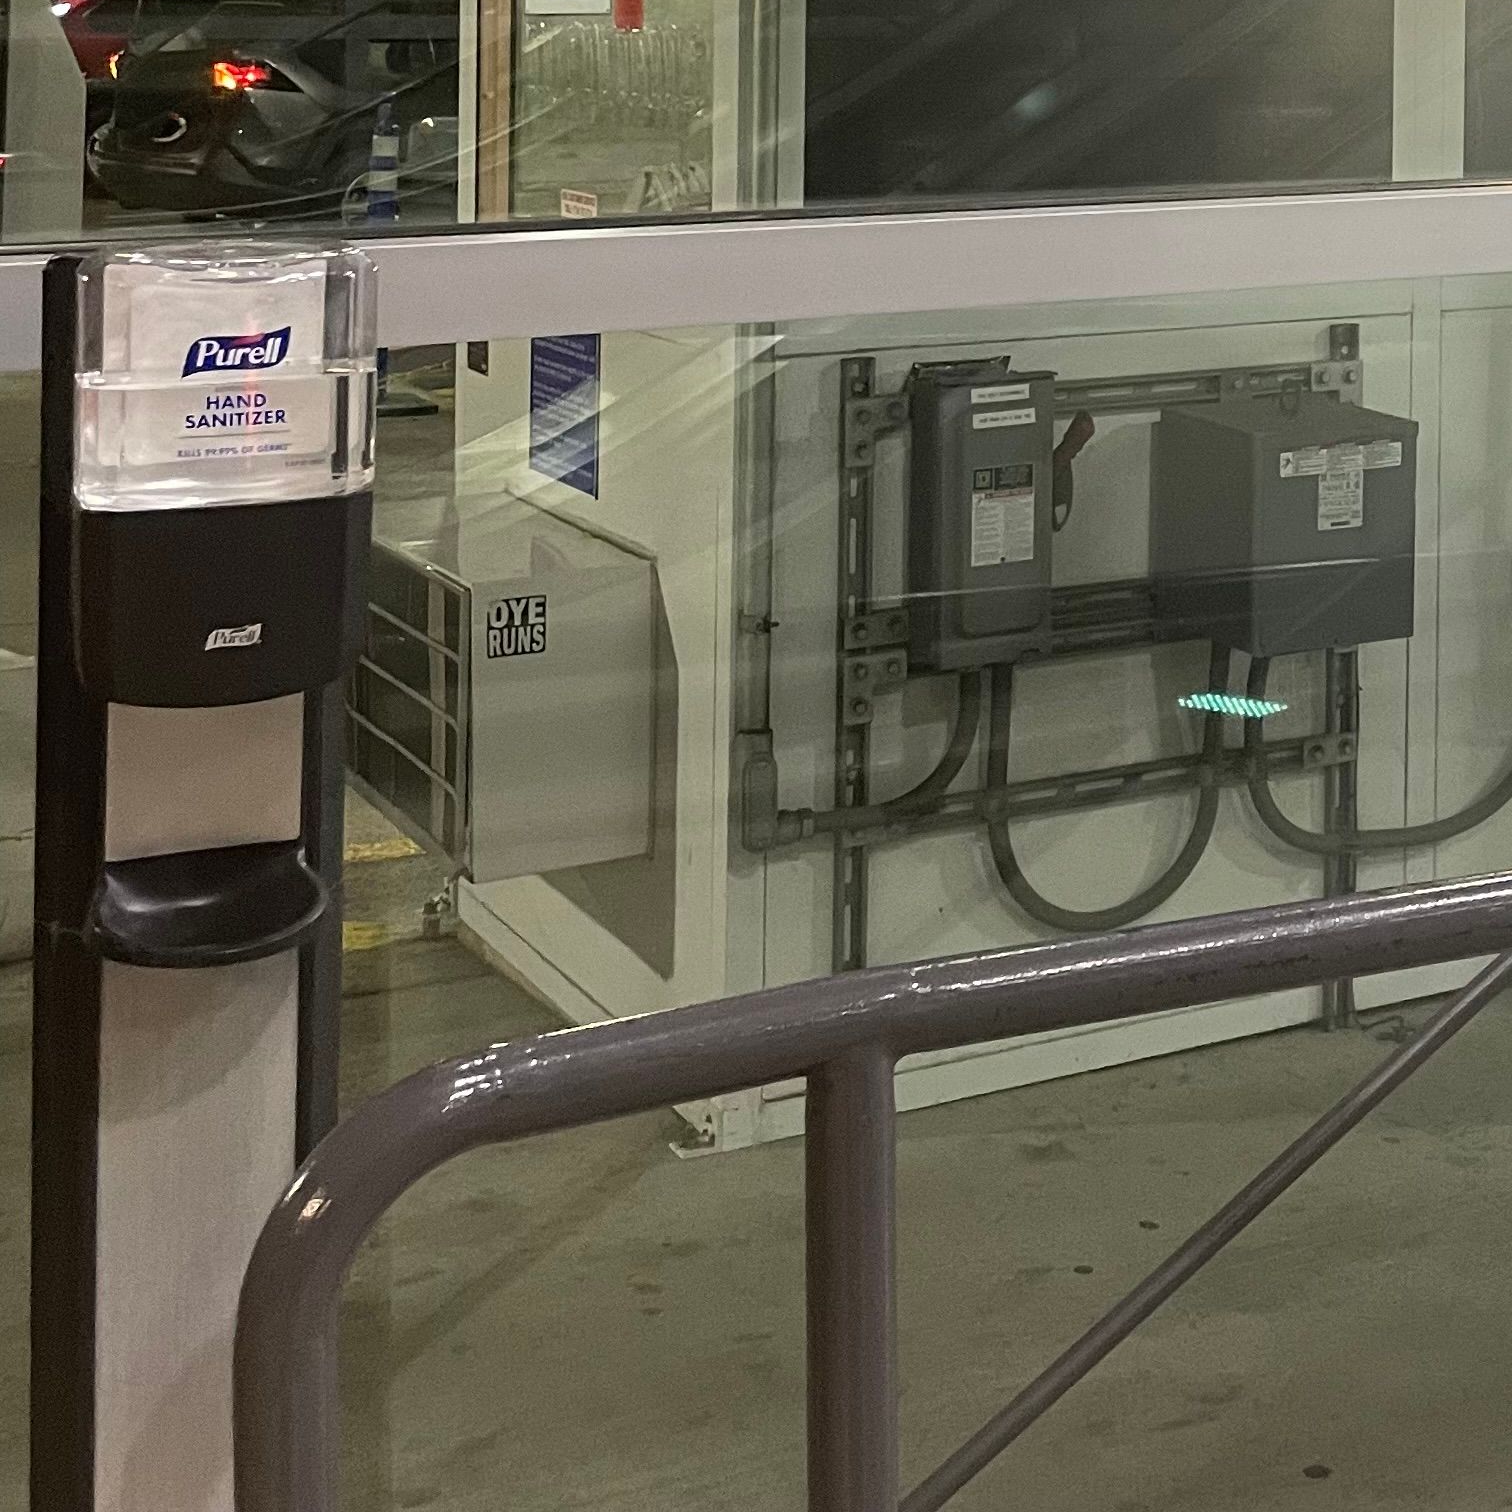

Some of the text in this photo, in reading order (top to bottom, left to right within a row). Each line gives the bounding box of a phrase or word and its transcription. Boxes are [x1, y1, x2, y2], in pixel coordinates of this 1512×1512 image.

[195, 337, 283, 368] Purell
[206, 393, 267, 410] HAND
[185, 409, 287, 429] SANITIZER
[488, 624, 545, 657] RUNS
